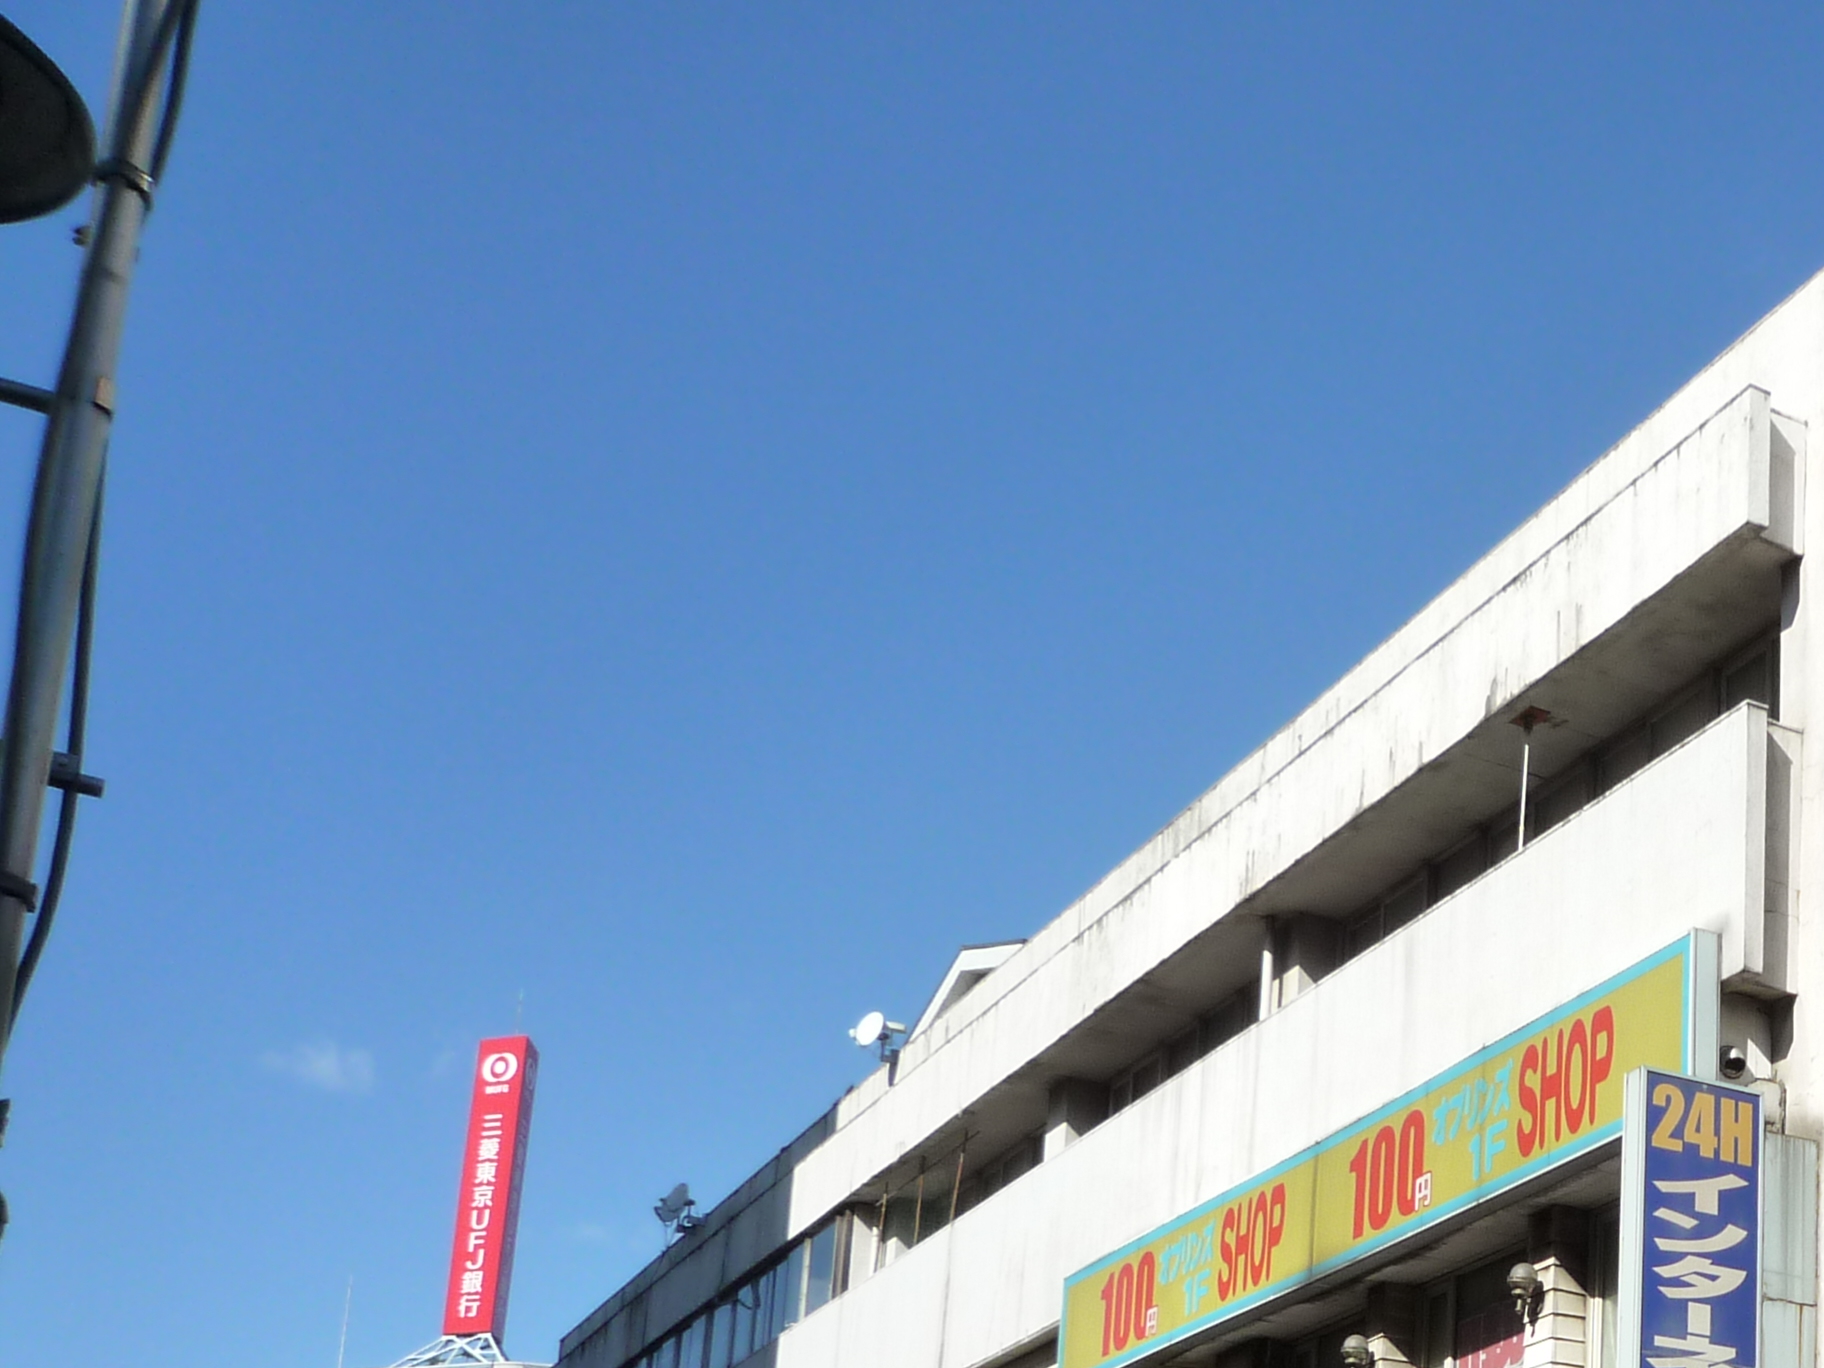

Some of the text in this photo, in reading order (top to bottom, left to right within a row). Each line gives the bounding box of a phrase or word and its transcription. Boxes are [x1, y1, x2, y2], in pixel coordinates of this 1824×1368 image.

[1349, 1109, 1432, 1241] 100円
[1516, 1004, 1614, 1158] SHOP
[1470, 1119, 1508, 1181] 1F
[1651, 1083, 1754, 1167] 24H
[457, 1113, 503, 1319] 三菱東京UFJ銀行
[1100, 1250, 1159, 1358] 100円
[1216, 1182, 1286, 1303] SHOP
